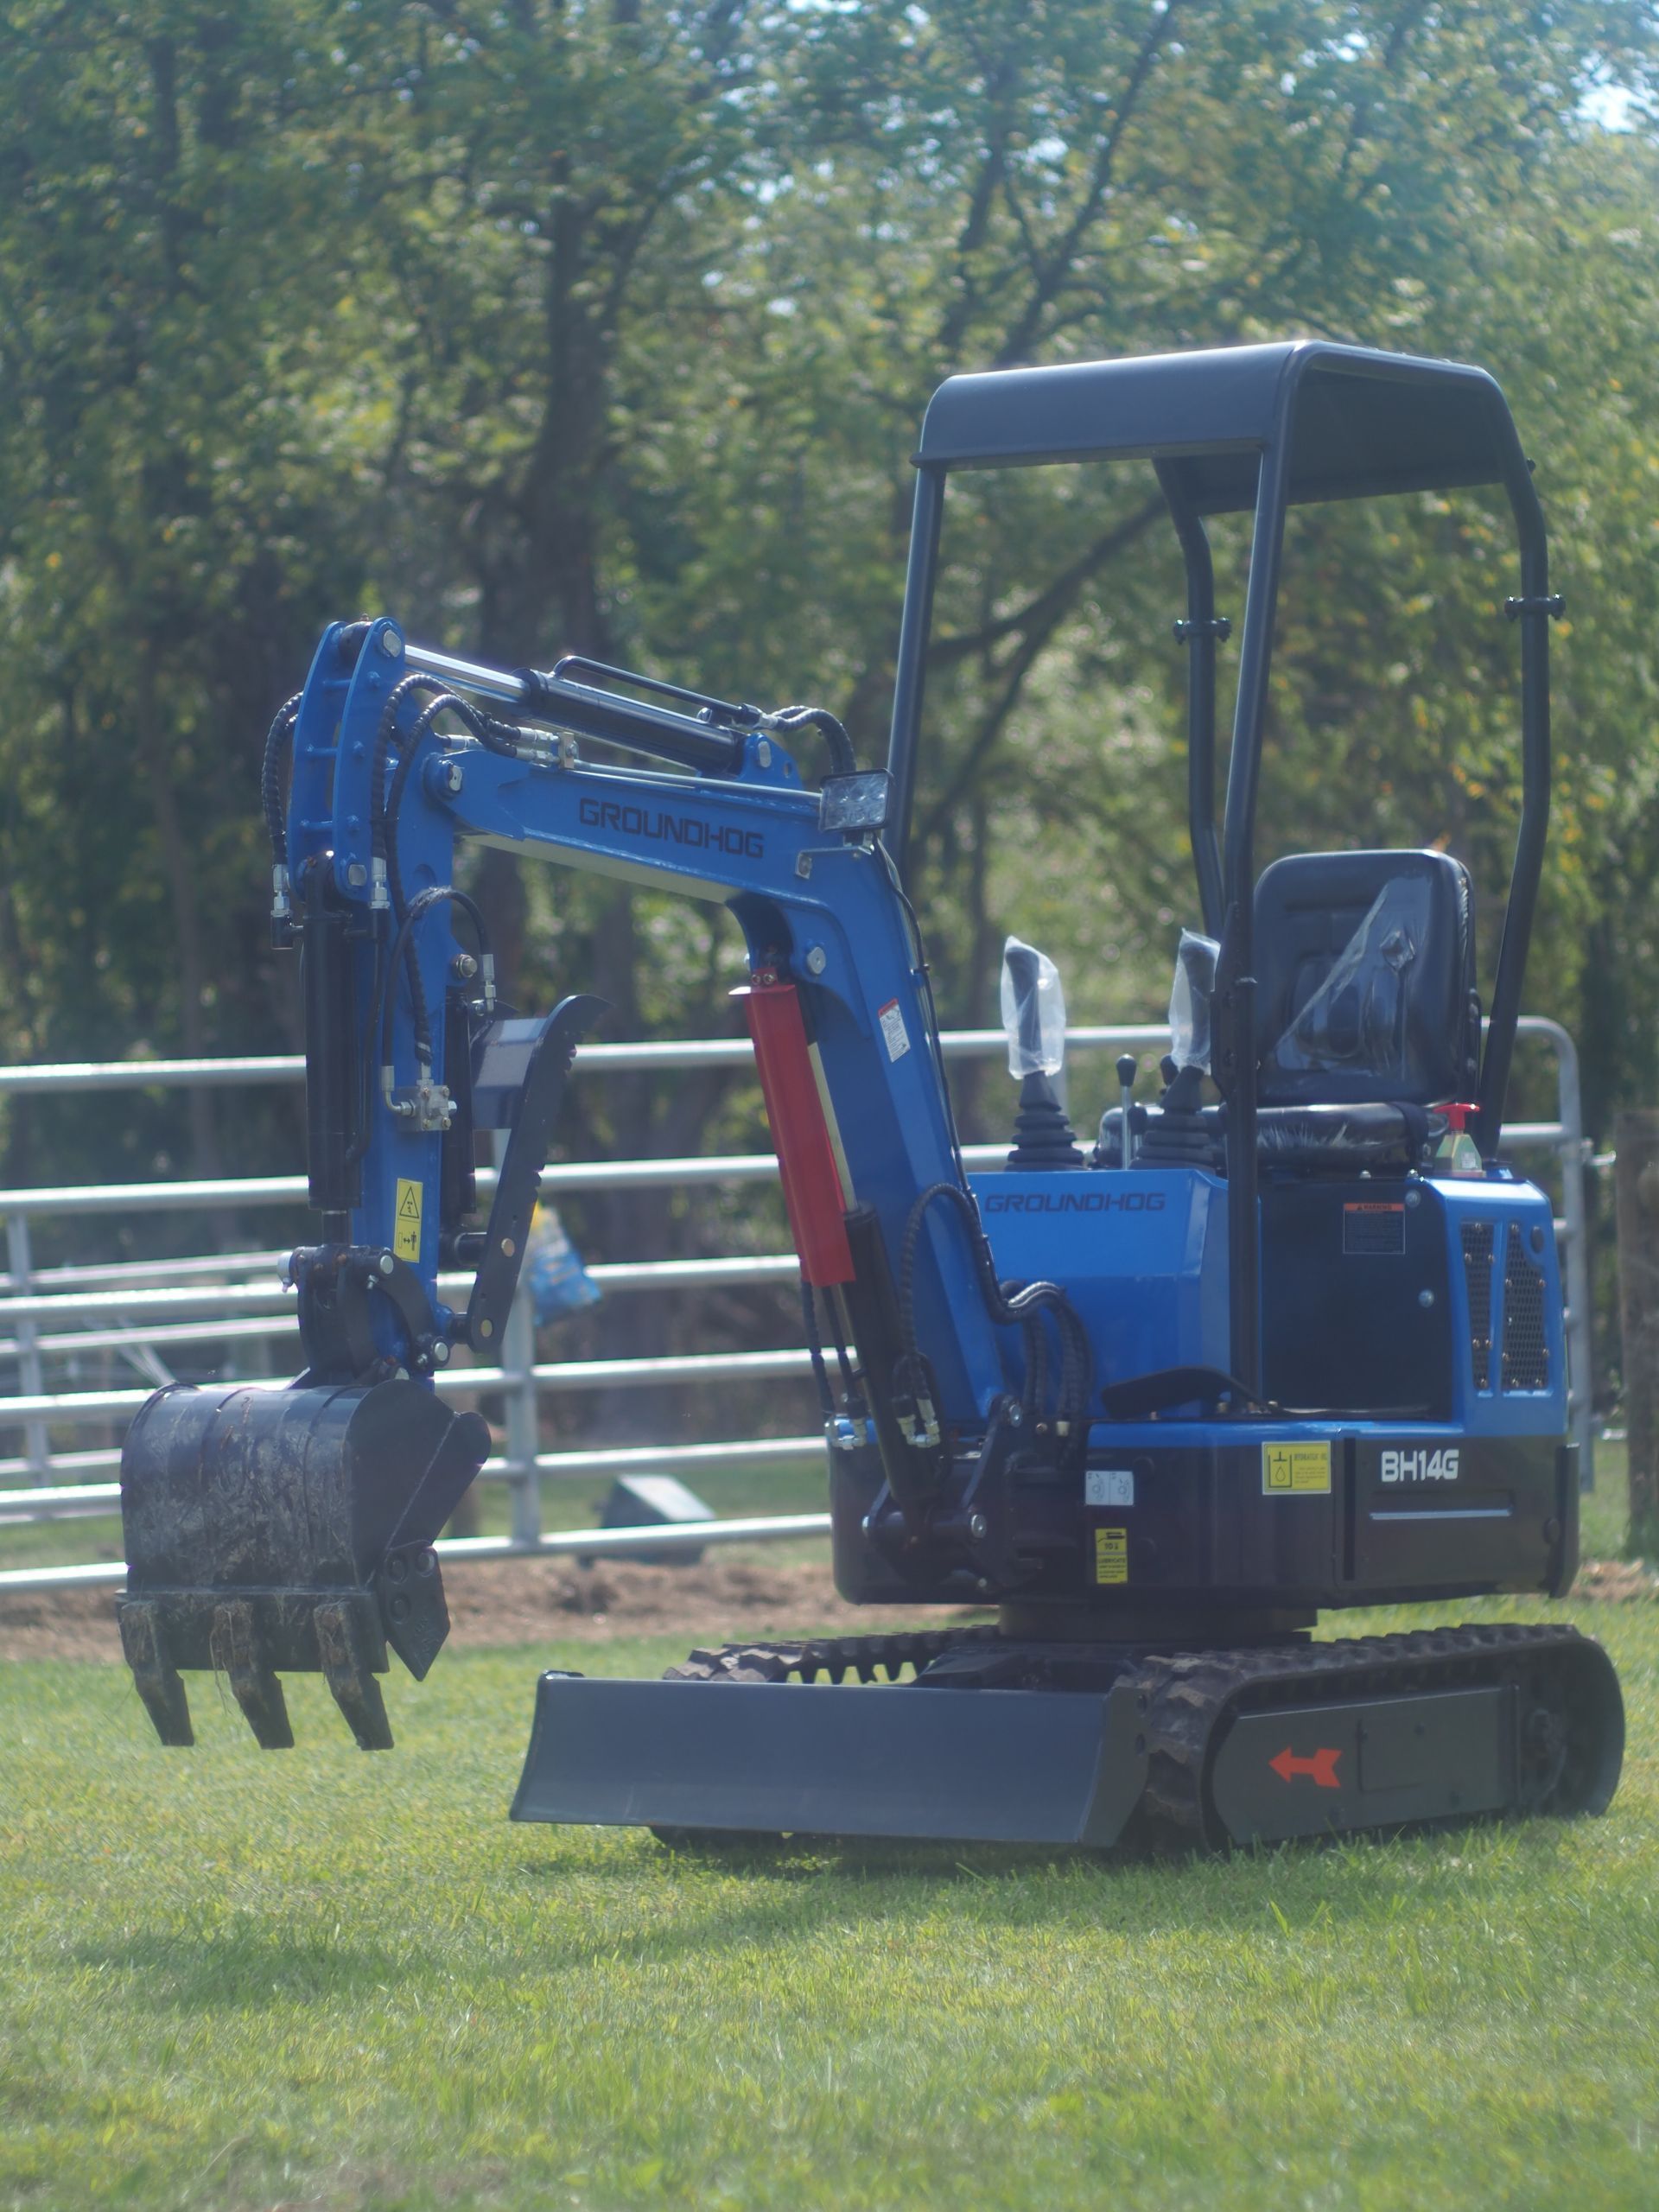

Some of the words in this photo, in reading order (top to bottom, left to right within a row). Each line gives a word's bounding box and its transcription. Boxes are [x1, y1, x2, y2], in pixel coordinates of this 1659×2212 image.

[579, 798, 765, 859] GROUNDHOG
[984, 1192, 1166, 1213] GROUNDHOG
[1381, 1449, 1459, 1483] BH14G
